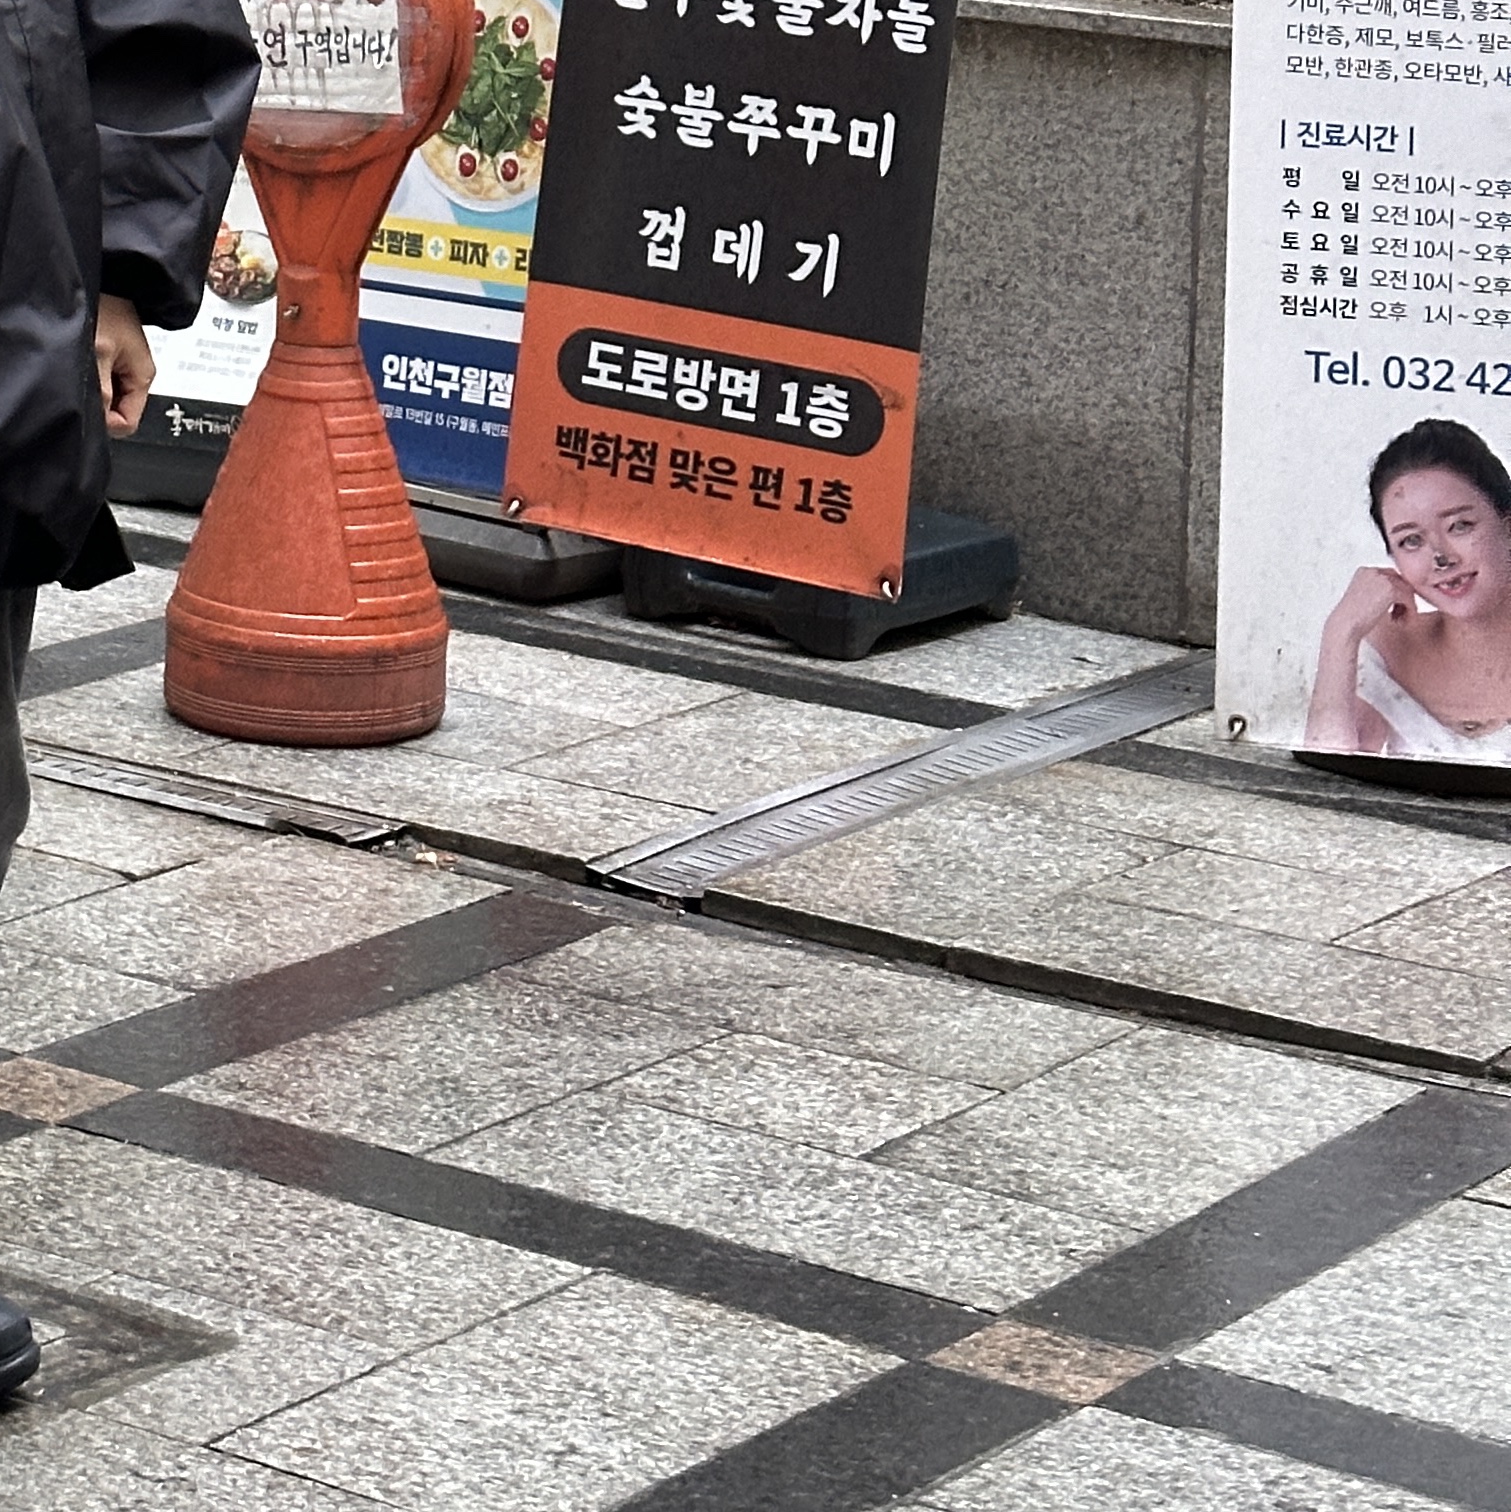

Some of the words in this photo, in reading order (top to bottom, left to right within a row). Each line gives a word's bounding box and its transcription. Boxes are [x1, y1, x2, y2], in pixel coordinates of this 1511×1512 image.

[254, 22, 288, 68] 연
[295, 25, 399, 69] 구역입니다!
[1286, 23, 1351, 49] 다한증,
[1354, 27, 1400, 51] 제모,
[1285, 55, 1330, 80] 모반,
[1334, 56, 1399, 83] 한관종,
[1402, 61, 1489, 88] 오타모반,
[613, 74, 898, 178] 숯불쭈꾸미
[1296, 121, 1399, 152] 진료시간
[1371, 172, 1410, 194] 오전
[1414, 175, 1455, 197] 10시
[1370, 204, 1409, 226] 오전
[1414, 207, 1455, 230] 10시
[449, 238, 489, 268] 피자
[638, 205, 841, 298] 껍데기
[1369, 236, 1408, 258] 오전
[1413, 239, 1454, 262] 10시
[1369, 268, 1408, 290] 오전
[1412, 271, 1454, 294] 10시
[1279, 294, 1359, 320] 점심시간
[1368, 300, 1408, 322] 오후
[1424, 304, 1453, 326] 1시
[381, 353, 515, 409] 인천구월점
[1304, 350, 1370, 387] Tel.
[1382, 355, 1456, 393] 032
[580, 339, 761, 423] 도로방면
[774, 380, 852, 440] 1층
[555, 423, 659, 485] 백화점
[668, 450, 739, 501] 맞은
[748, 465, 786, 511] 편
[794, 477, 854, 525] 1층
